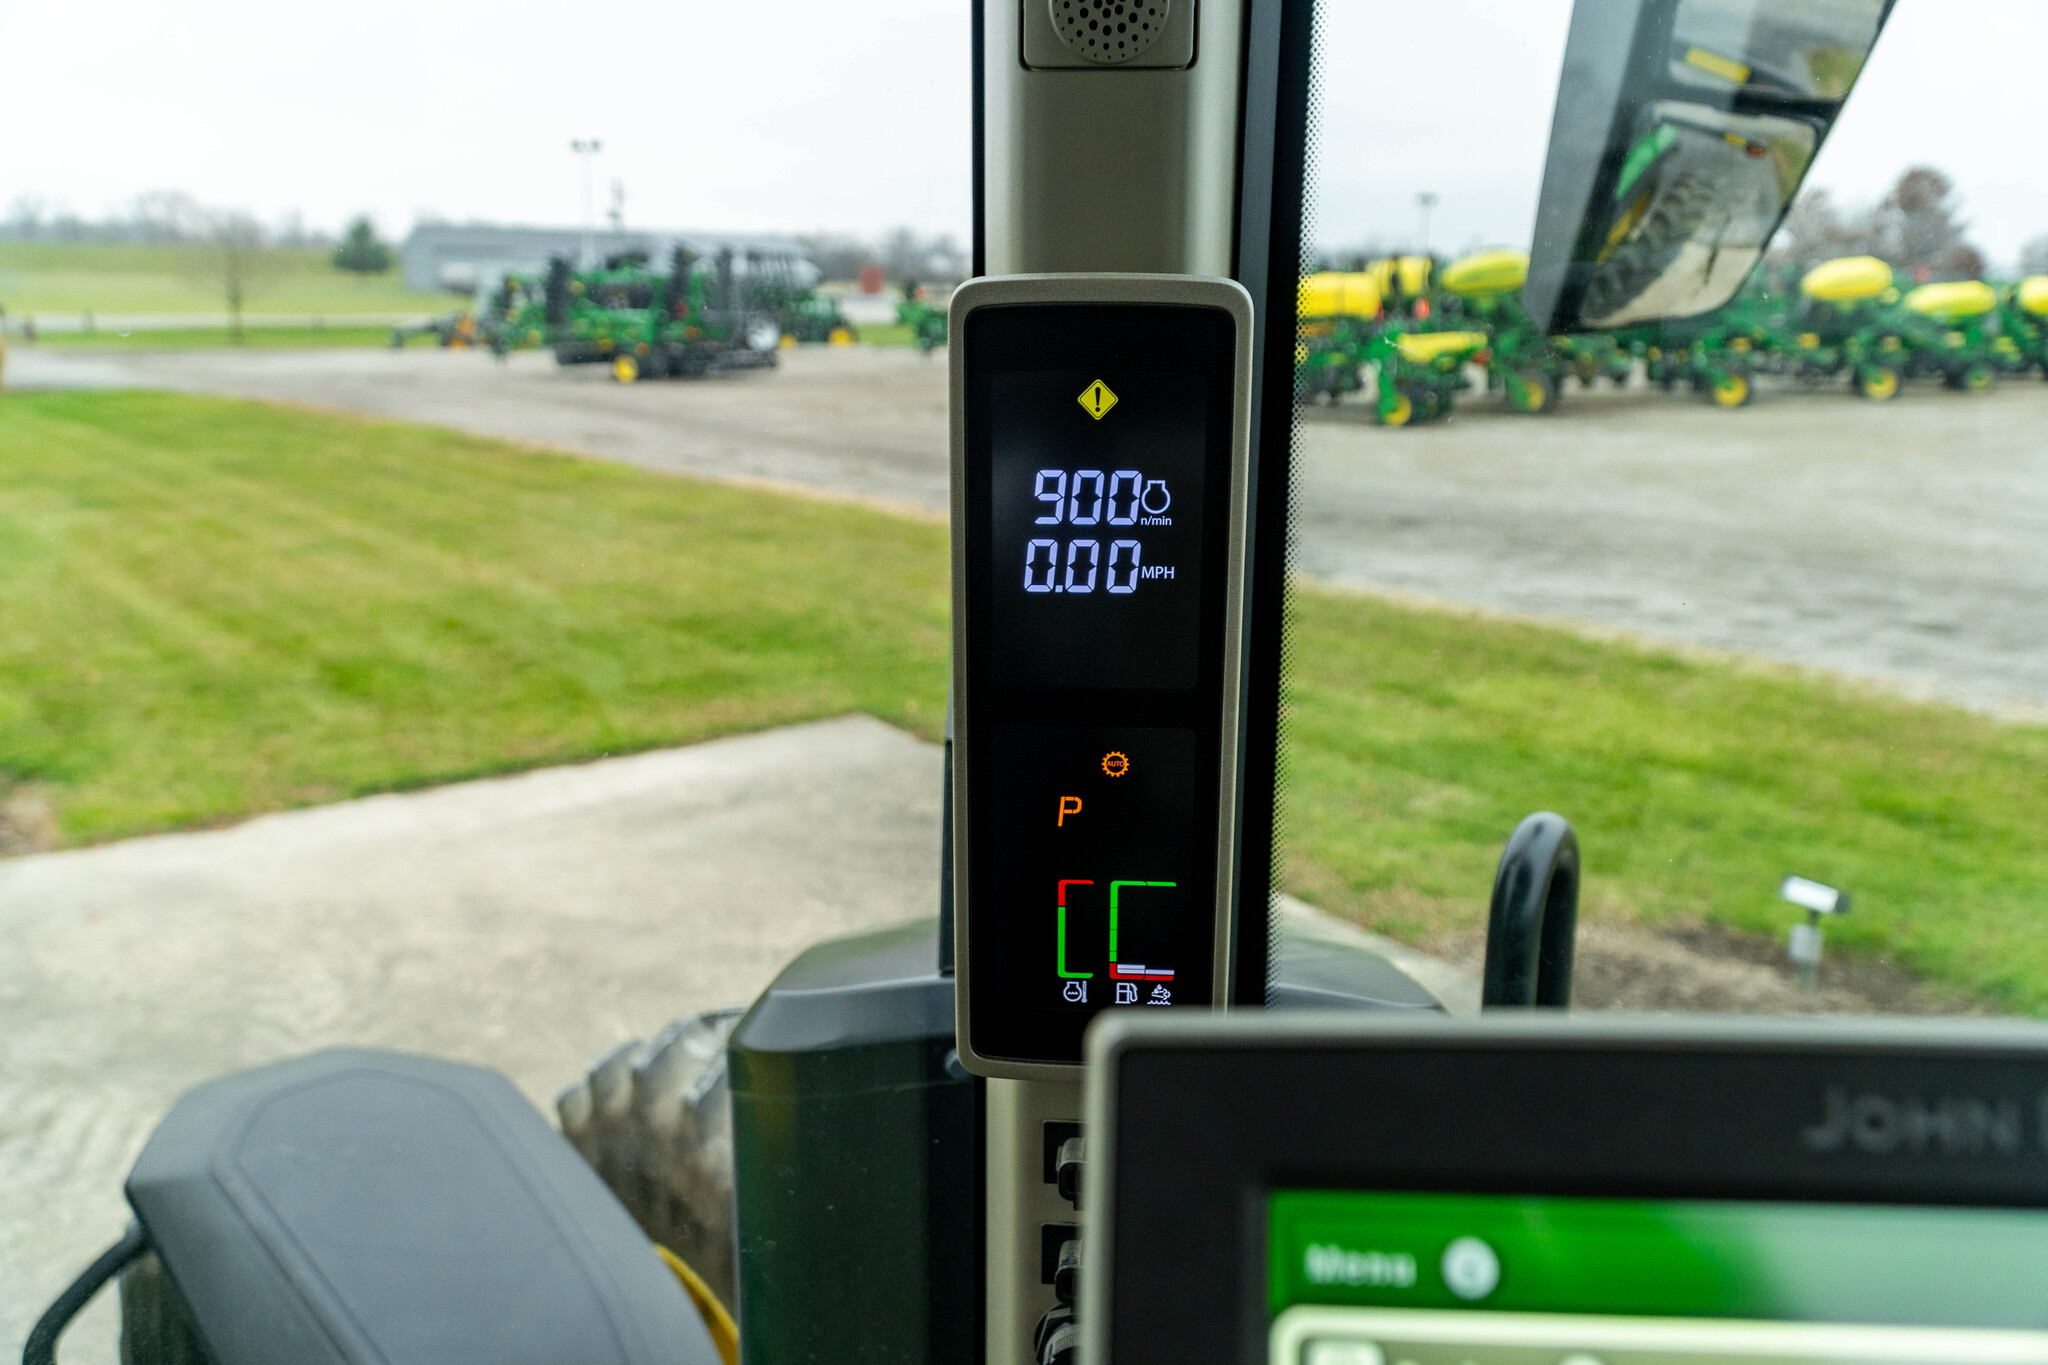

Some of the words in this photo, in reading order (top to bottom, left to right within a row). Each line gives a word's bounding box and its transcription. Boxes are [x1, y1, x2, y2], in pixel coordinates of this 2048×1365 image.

[1034, 469, 1142, 525] 900
[1140, 516, 1172, 526] n/min
[1023, 538, 1141, 593] 0.00
[1141, 566, 1175, 579] MPH
[1107, 760, 1125, 768] AUTO
[1057, 796, 1082, 826] P
[1803, 1088, 2019, 1153] JOHN
[1305, 1243, 1416, 1288] Menu
